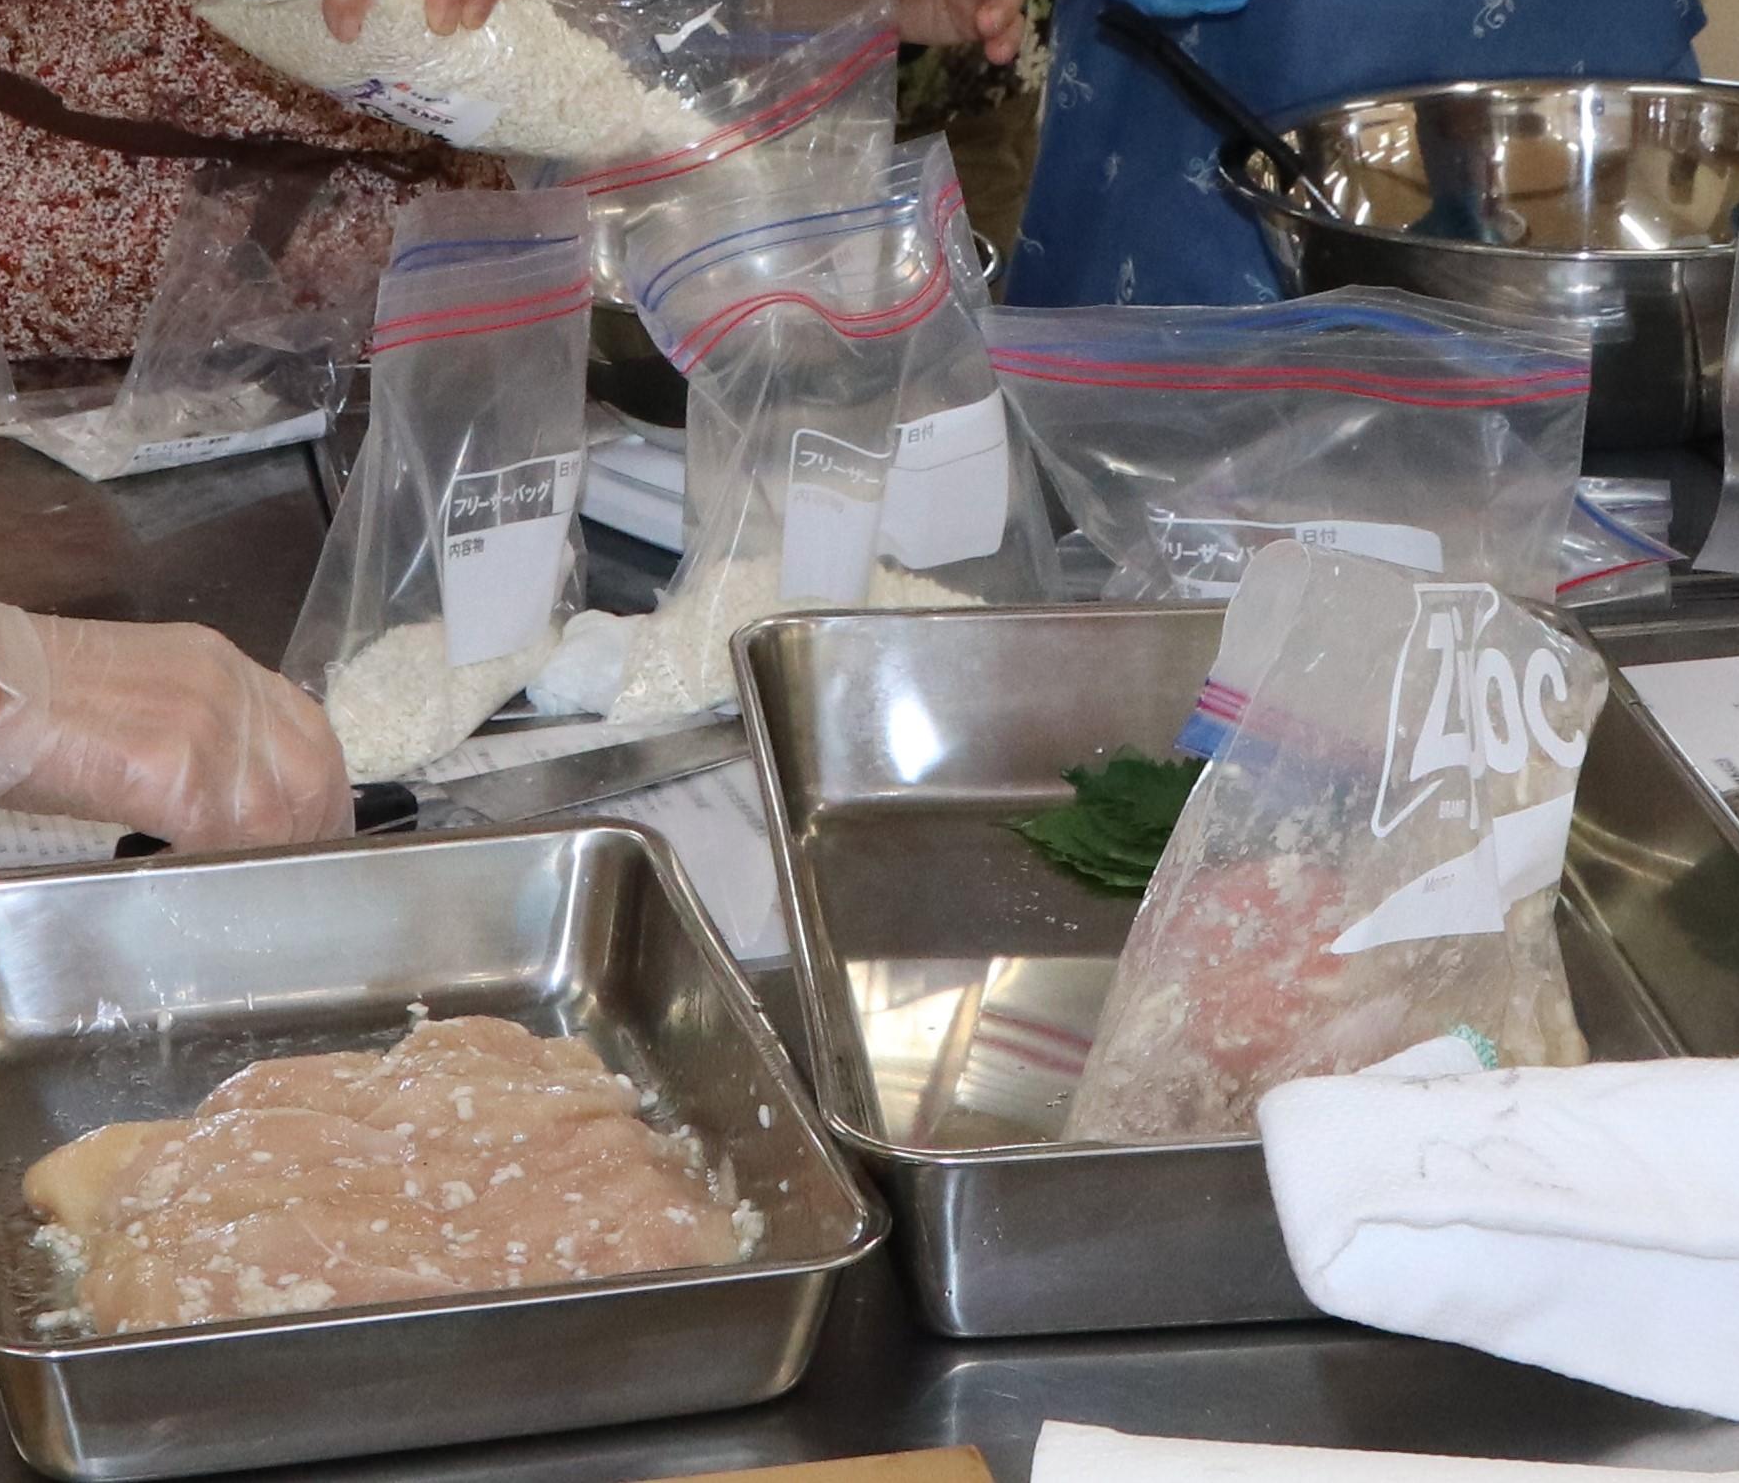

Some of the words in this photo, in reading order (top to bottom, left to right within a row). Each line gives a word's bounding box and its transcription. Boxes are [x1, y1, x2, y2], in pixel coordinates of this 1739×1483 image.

[909, 421, 935, 445] 日付
[453, 478, 553, 518] フリーザーバッグ
[449, 537, 486, 559] 内容物
[1301, 527, 1339, 546] 日付
